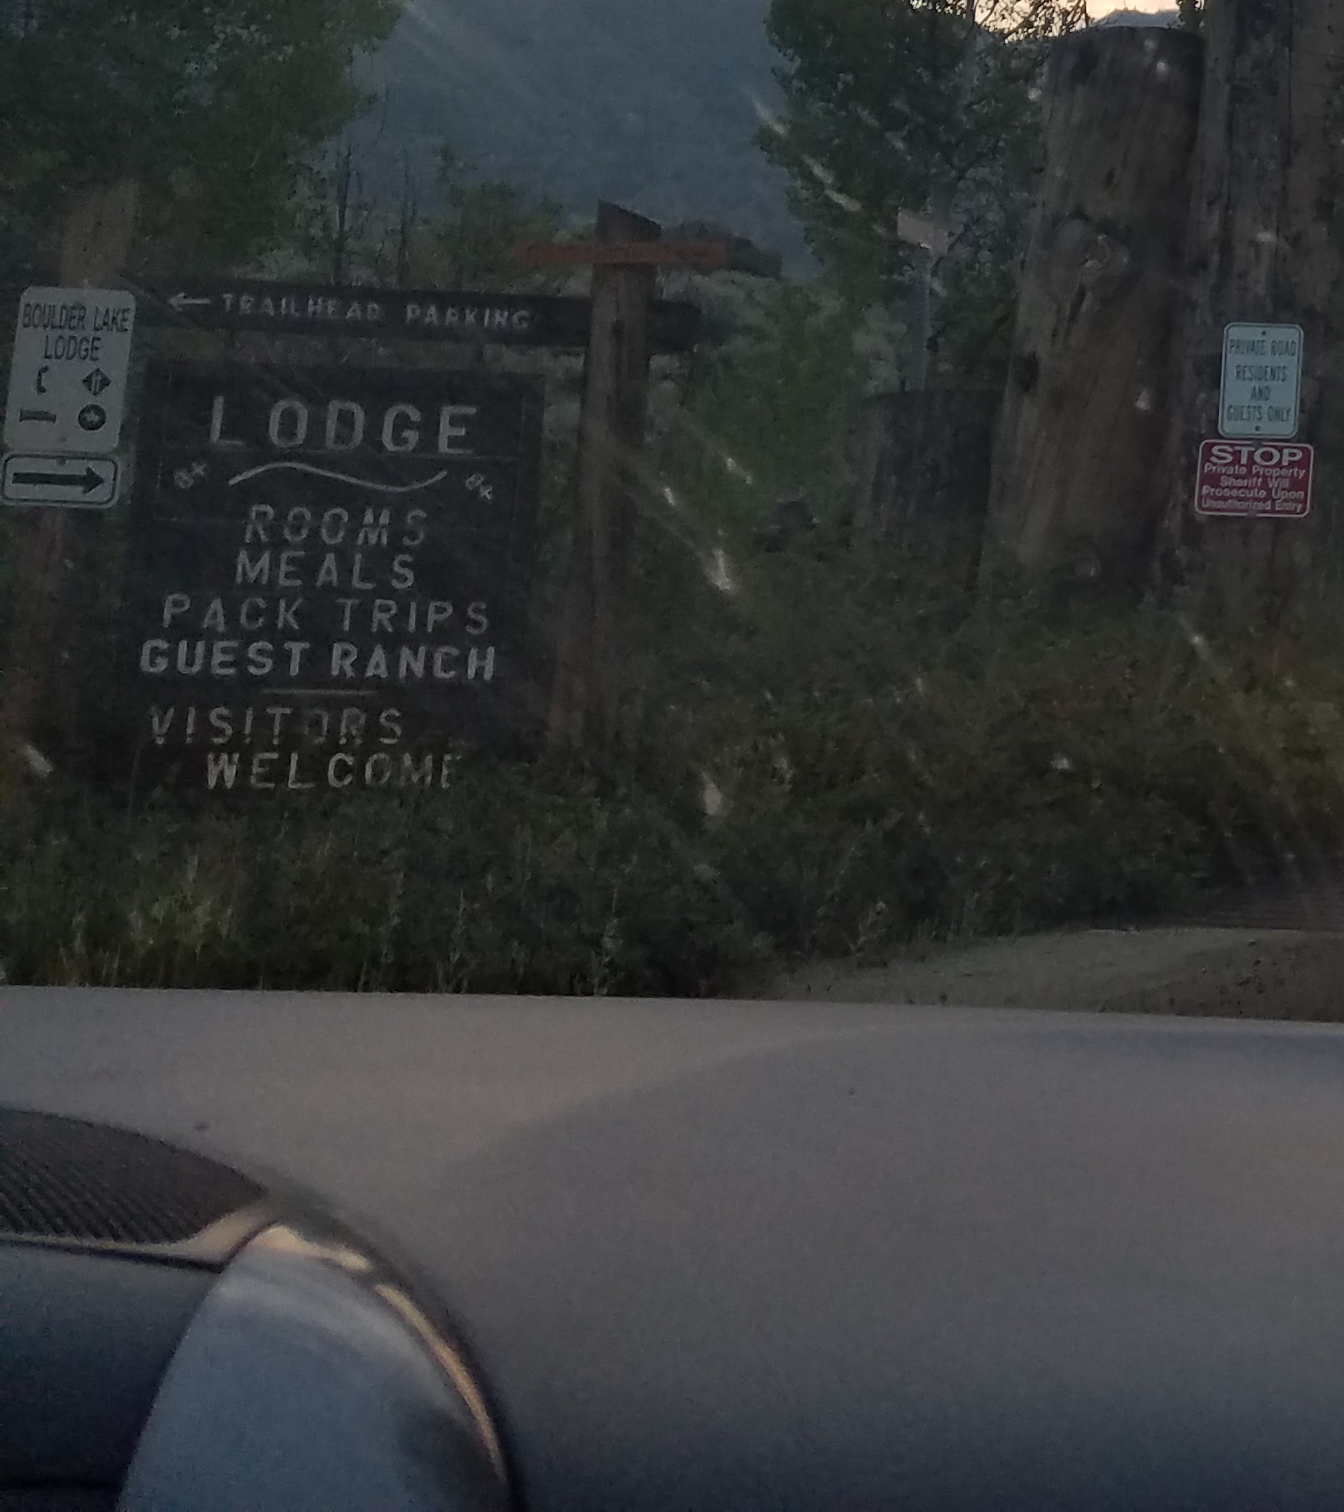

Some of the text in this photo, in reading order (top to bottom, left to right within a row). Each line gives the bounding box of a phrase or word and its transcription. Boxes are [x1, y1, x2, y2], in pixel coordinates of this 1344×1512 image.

[22, 302, 131, 333] BOULDER LAKE
[221, 293, 531, 330] TRAILHEAD PARKING
[43, 334, 102, 362] LODGE
[1228, 338, 1297, 357] PRIVATE ROAD
[1235, 364, 1287, 383] RESIDENTS
[1250, 385, 1271, 402] AND
[208, 394, 481, 455] LODGE
[1226, 404, 1292, 422] GUESTS ONLY
[1210, 444, 1303, 466] STOP
[1203, 462, 1306, 479] Private Property
[1219, 475, 1290, 489] Sheriff Will
[1201, 484, 1305, 501] Prosecute Upon
[1201, 497, 1303, 513] Unauthorized Entry
[244, 503, 428, 547] ROOMS
[235, 549, 415, 590] MEALS
[162, 592, 488, 636] PACK TRIPS
[139, 638, 496, 681] GUEST RANCH
[149, 705, 403, 746] VISITORS
